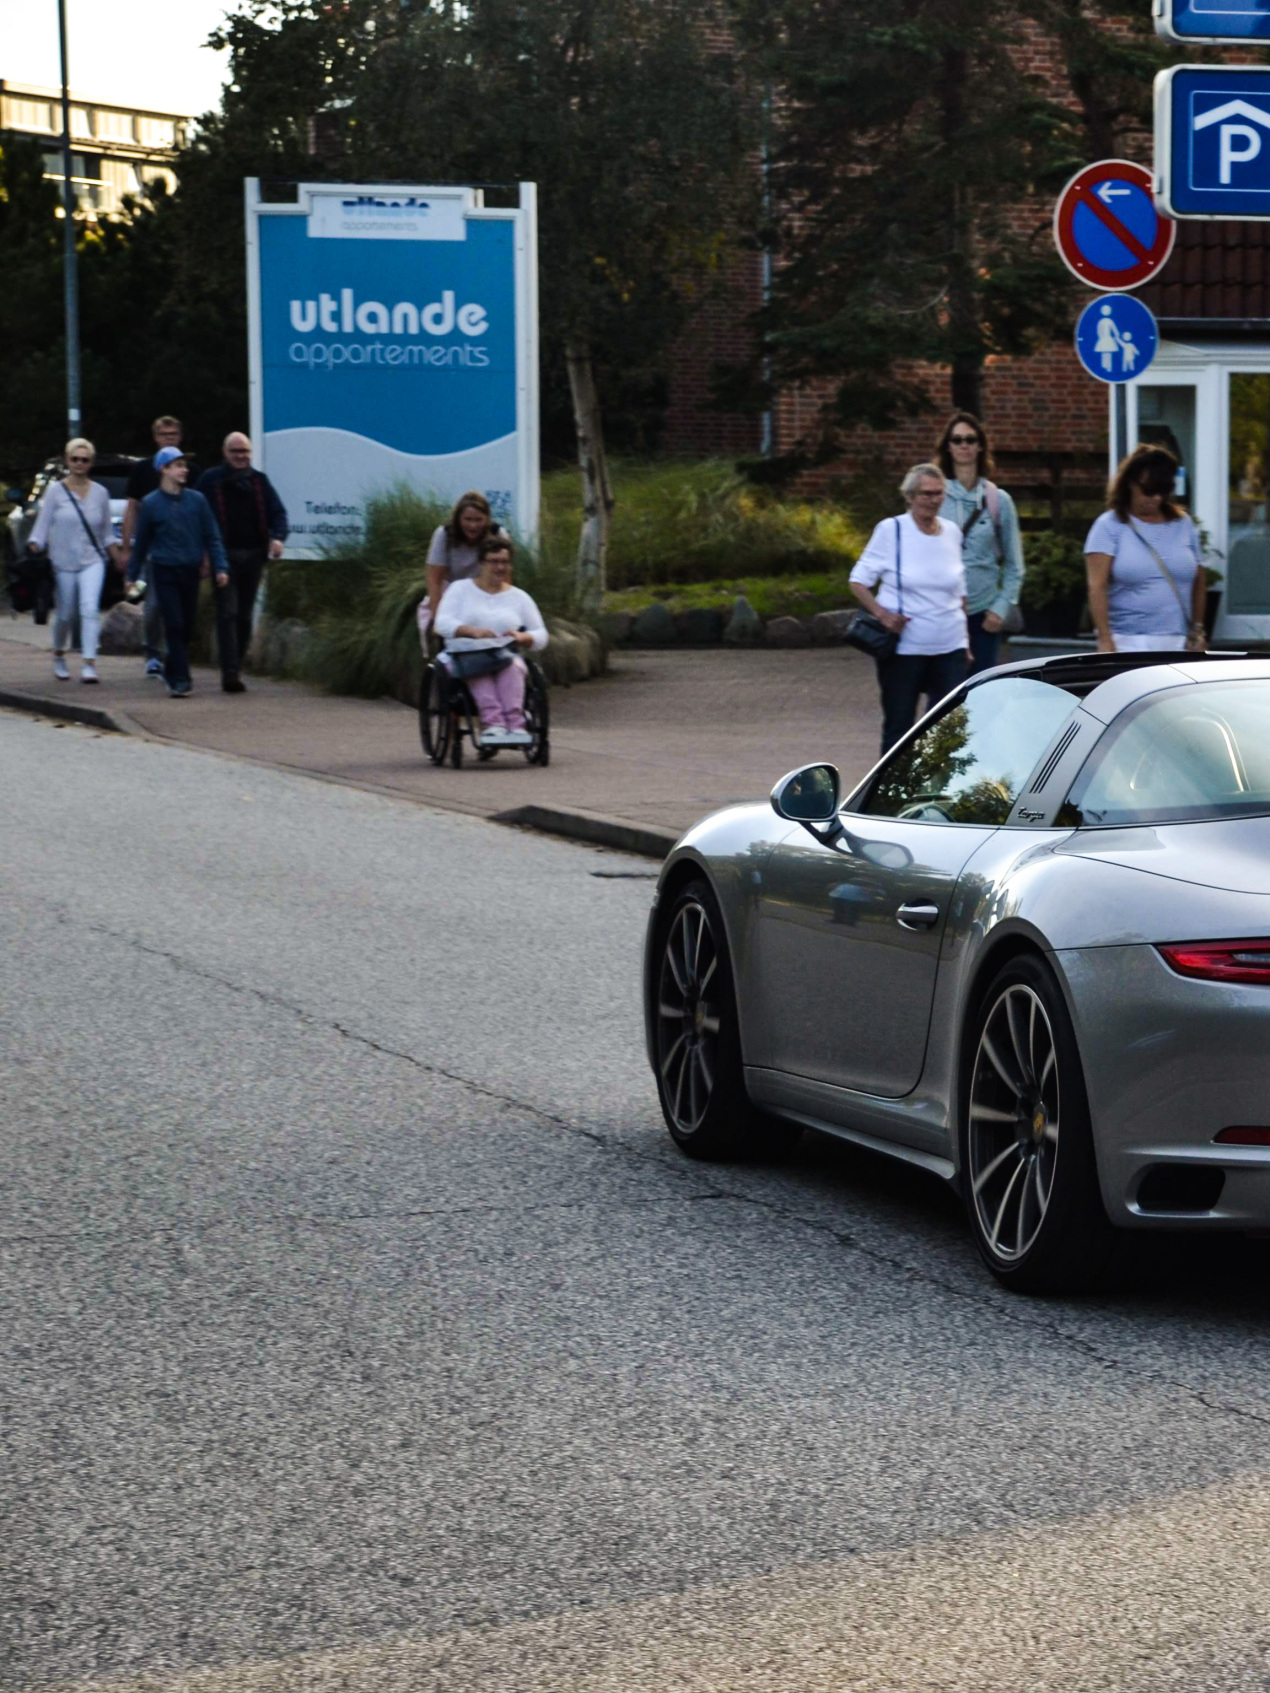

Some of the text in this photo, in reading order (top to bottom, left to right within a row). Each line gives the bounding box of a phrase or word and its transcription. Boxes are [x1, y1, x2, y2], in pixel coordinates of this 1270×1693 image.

[1219, 124, 1262, 185] P
[289, 288, 489, 337] utlande
[289, 341, 490, 371] appartements
